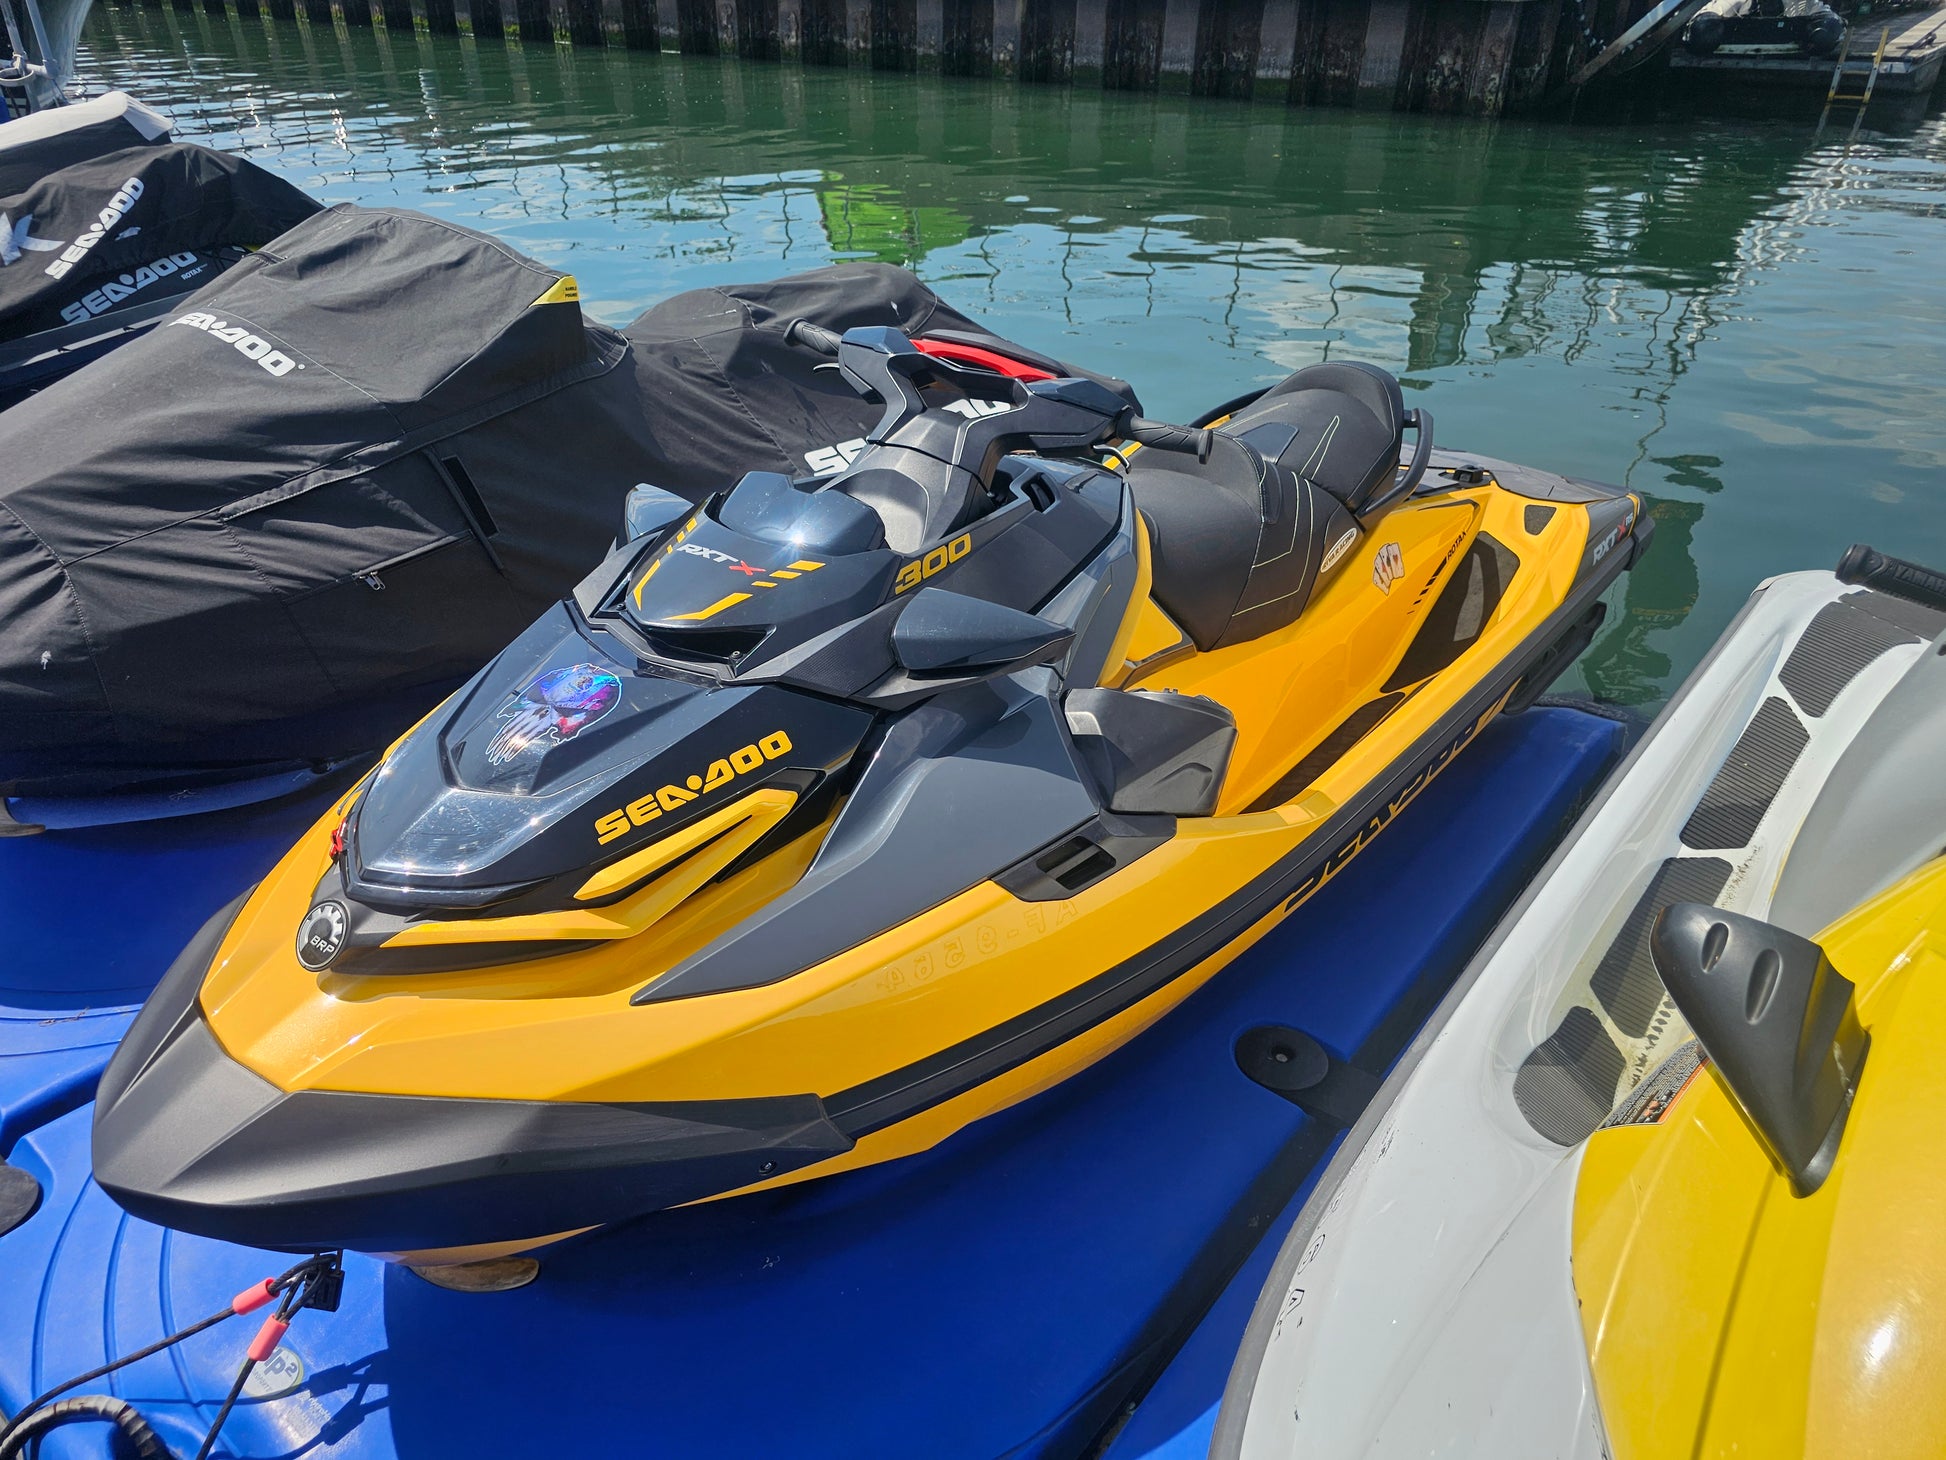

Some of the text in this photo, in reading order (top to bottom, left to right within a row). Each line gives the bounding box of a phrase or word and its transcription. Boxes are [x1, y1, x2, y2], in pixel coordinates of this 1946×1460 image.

[181, 267, 203, 280] ROTAX
[676, 543, 739, 563] RXT
[1446, 530, 1467, 561] ROTAX
[894, 533, 972, 595] 300
[309, 935, 335, 953] BRP
